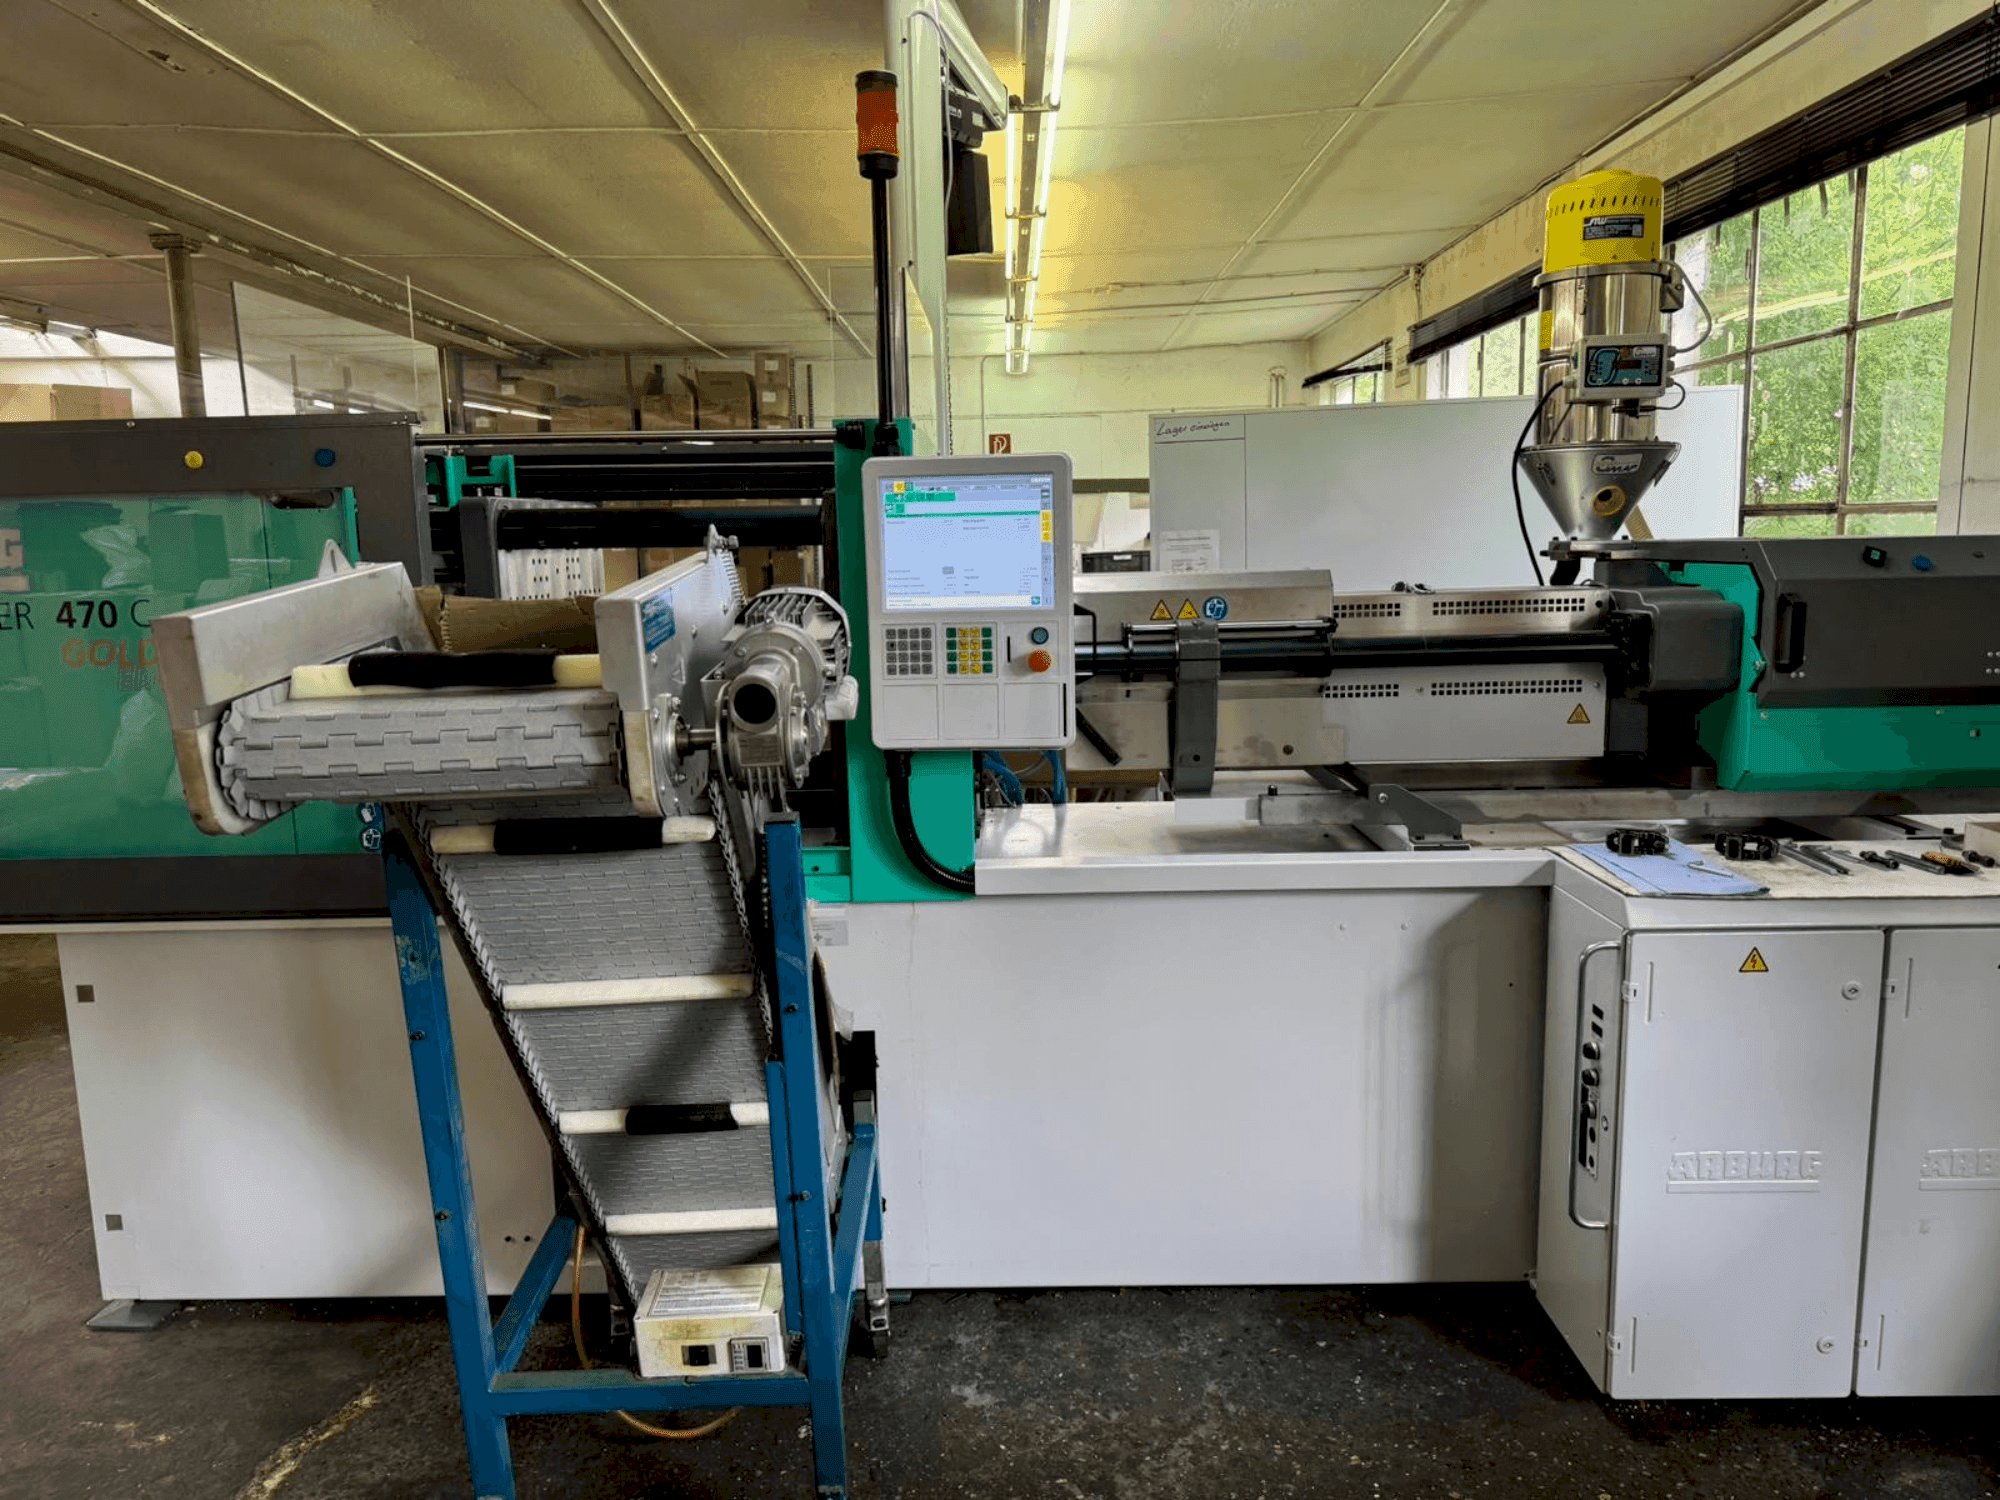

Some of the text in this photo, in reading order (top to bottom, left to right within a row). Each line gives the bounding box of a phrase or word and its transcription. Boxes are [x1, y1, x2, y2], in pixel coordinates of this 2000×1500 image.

[56, 600, 118, 629] 470
[61, 638, 158, 669] GOLD
[1666, 1150, 1821, 1180] ARBURG
